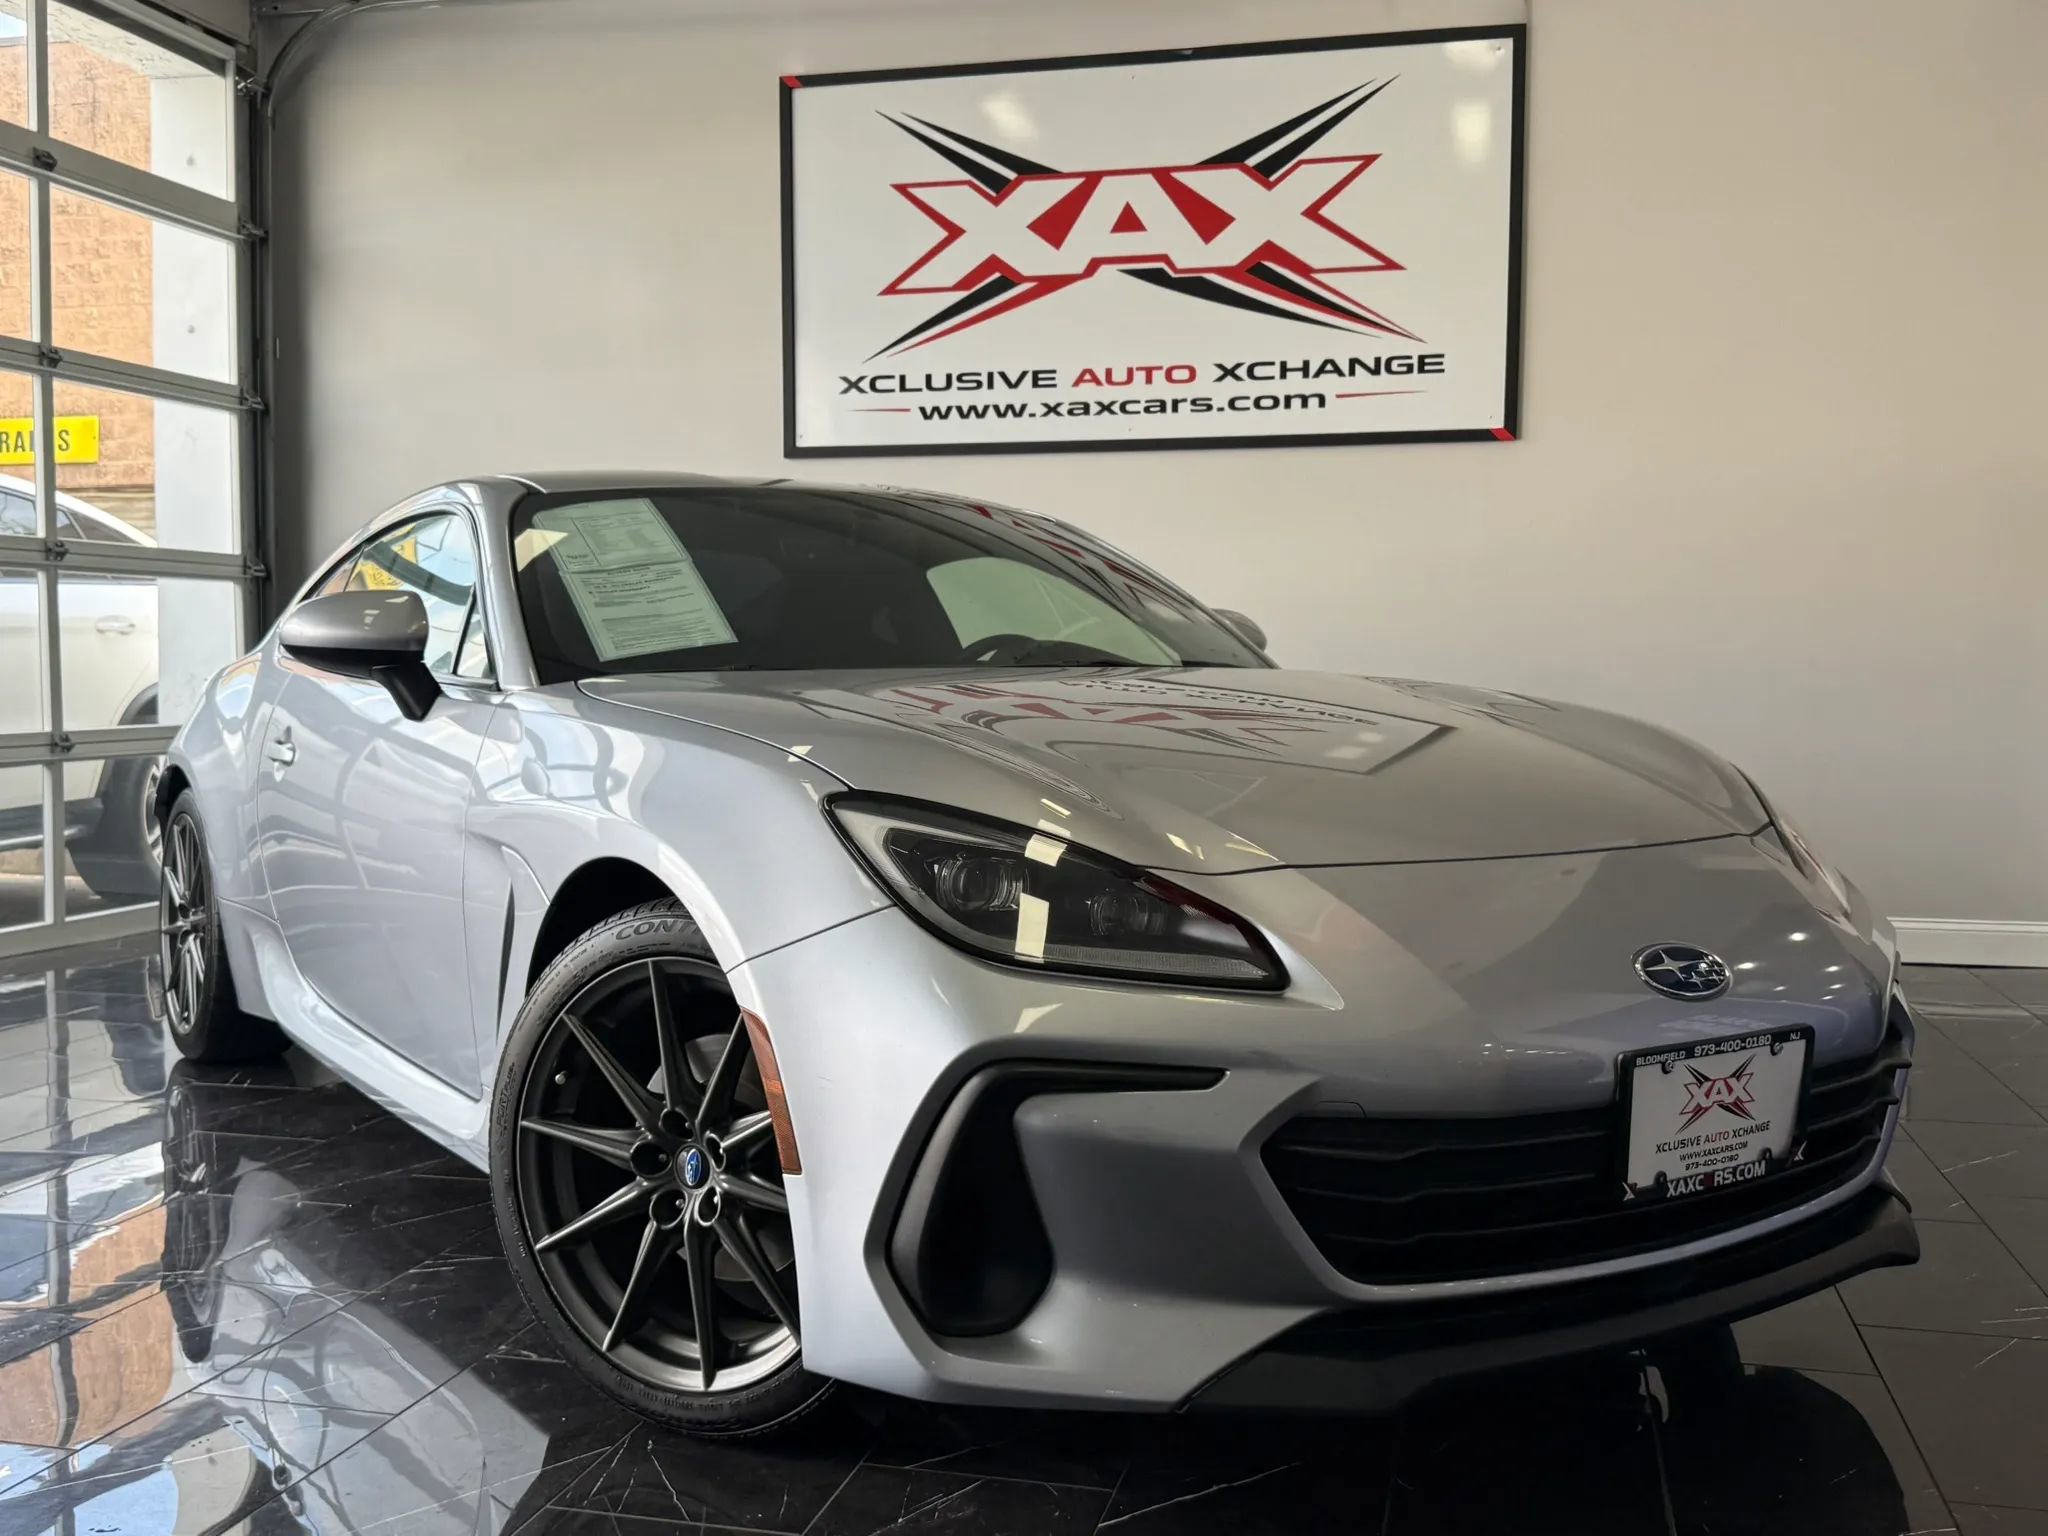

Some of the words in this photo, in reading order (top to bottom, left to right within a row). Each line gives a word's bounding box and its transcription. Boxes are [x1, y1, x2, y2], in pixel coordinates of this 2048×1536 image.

[877, 153, 1407, 297] XAX
[838, 369, 1058, 395] XCLUSIVE
[1071, 364, 1198, 388] AUTO
[1212, 353, 1446, 383] XCHANGE
[918, 389, 1327, 421] www.xaxcars.com
[1636, 1050, 1686, 1066] BLOOMFIELD
[1694, 1034, 1772, 1057] 973-400-0180
[1789, 1031, 1801, 1041] NJ
[1679, 1071, 1756, 1116] XAX
[1655, 1135, 1702, 1154] XCLUSIVE
[1703, 1130, 1730, 1144] AUTO
[1731, 1120, 1771, 1139] XCHANGE
[1679, 1141, 1748, 1161] WWW.XAXCARS.COM
[1666, 1160, 1766, 1198] XAXCRS.COM
